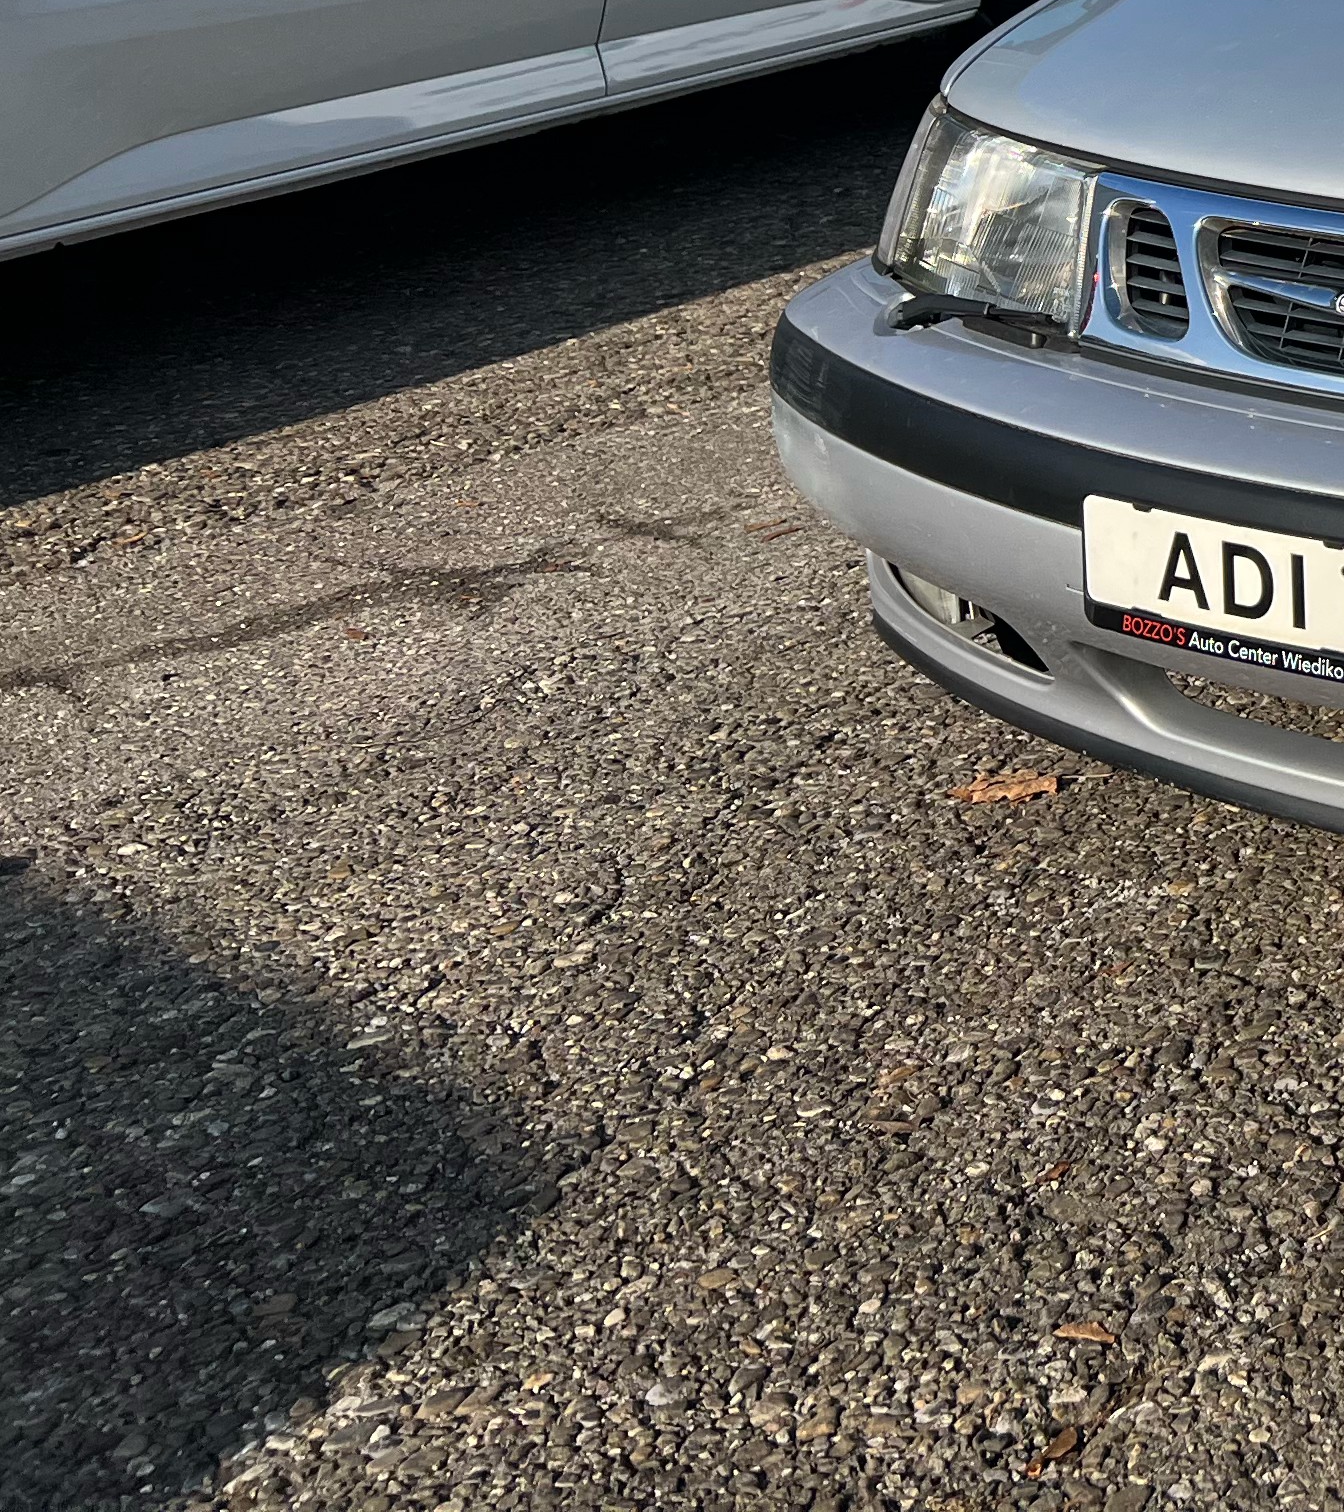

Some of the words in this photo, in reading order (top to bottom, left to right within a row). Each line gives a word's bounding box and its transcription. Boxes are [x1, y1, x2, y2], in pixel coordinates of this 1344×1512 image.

[1158, 531, 1306, 630] ADI
[1122, 615, 1185, 645] BOZZO'S
[1189, 631, 1225, 654] Auto
[1228, 640, 1278, 666] Center
